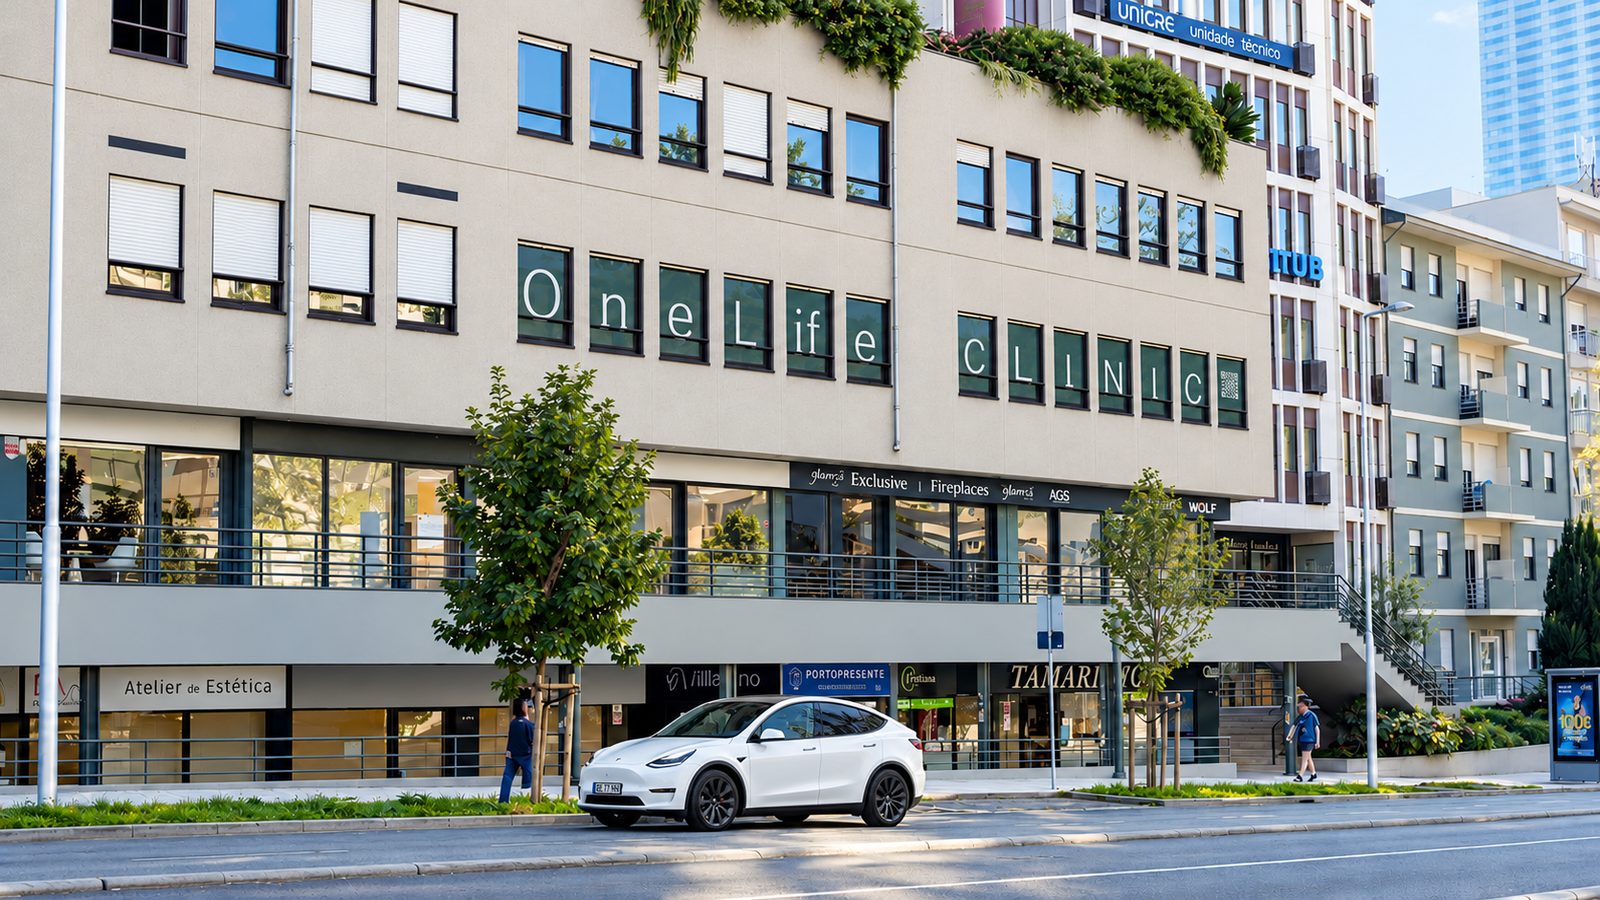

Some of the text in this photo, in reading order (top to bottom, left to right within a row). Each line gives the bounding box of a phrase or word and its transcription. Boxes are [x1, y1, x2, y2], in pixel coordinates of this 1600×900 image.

[1189, 25, 1234, 47] unidade
[964, 338, 1202, 405] CLINIC
[851, 472, 908, 490] Exclusive
[931, 479, 990, 497] Fireplaces
[1049, 489, 1070, 501] AGS
[1189, 501, 1217, 514] WOLF
[805, 669, 885, 679] PORTOPRESENTE
[124, 678, 272, 695] Atelier de Estética
